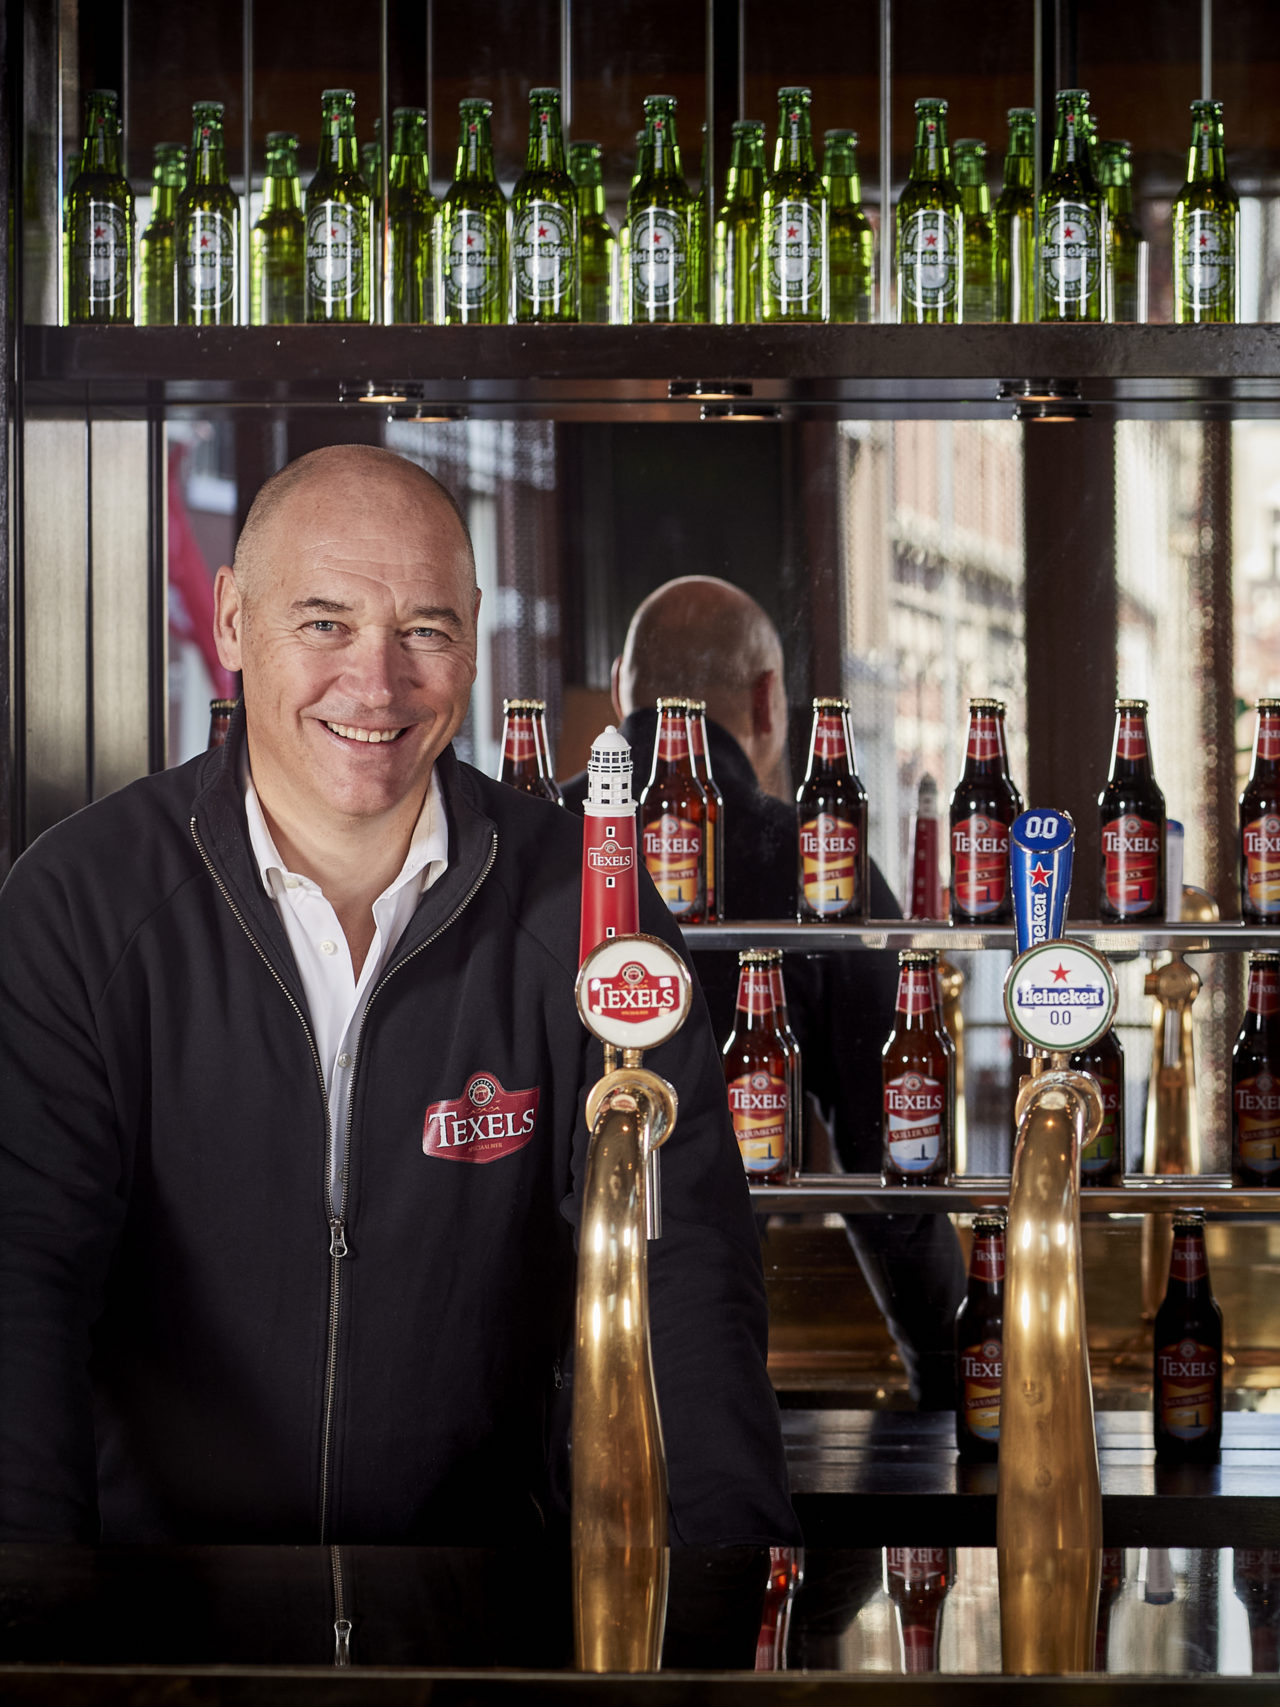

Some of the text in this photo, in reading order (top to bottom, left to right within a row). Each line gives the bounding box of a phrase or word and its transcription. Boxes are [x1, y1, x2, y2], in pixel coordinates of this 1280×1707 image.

[445, 253, 498, 267] eineken
[767, 246, 821, 258] Heneken
[902, 251, 958, 266] Heneken
[1177, 253, 1234, 267] eineken
[1025, 816, 1059, 839] 0.0
[643, 833, 699, 853] TEXELS
[800, 832, 856, 853] TEXELS
[953, 831, 1009, 853] TEXELS
[1104, 831, 1160, 853] TEXELS
[590, 852, 631, 866] TEXELS
[1032, 892, 1047, 945] neken
[598, 983, 675, 1009] TEXELS
[1020, 988, 1100, 1005] Heineken
[1050, 1010, 1071, 1026] 0.0
[730, 1088, 787, 1109] TEXELS
[885, 1089, 942, 1109] TEXELS
[429, 1108, 535, 1148] TEXELS
[962, 1357, 1002, 1377] TEXE
[1160, 1356, 1217, 1377] TEXELS
